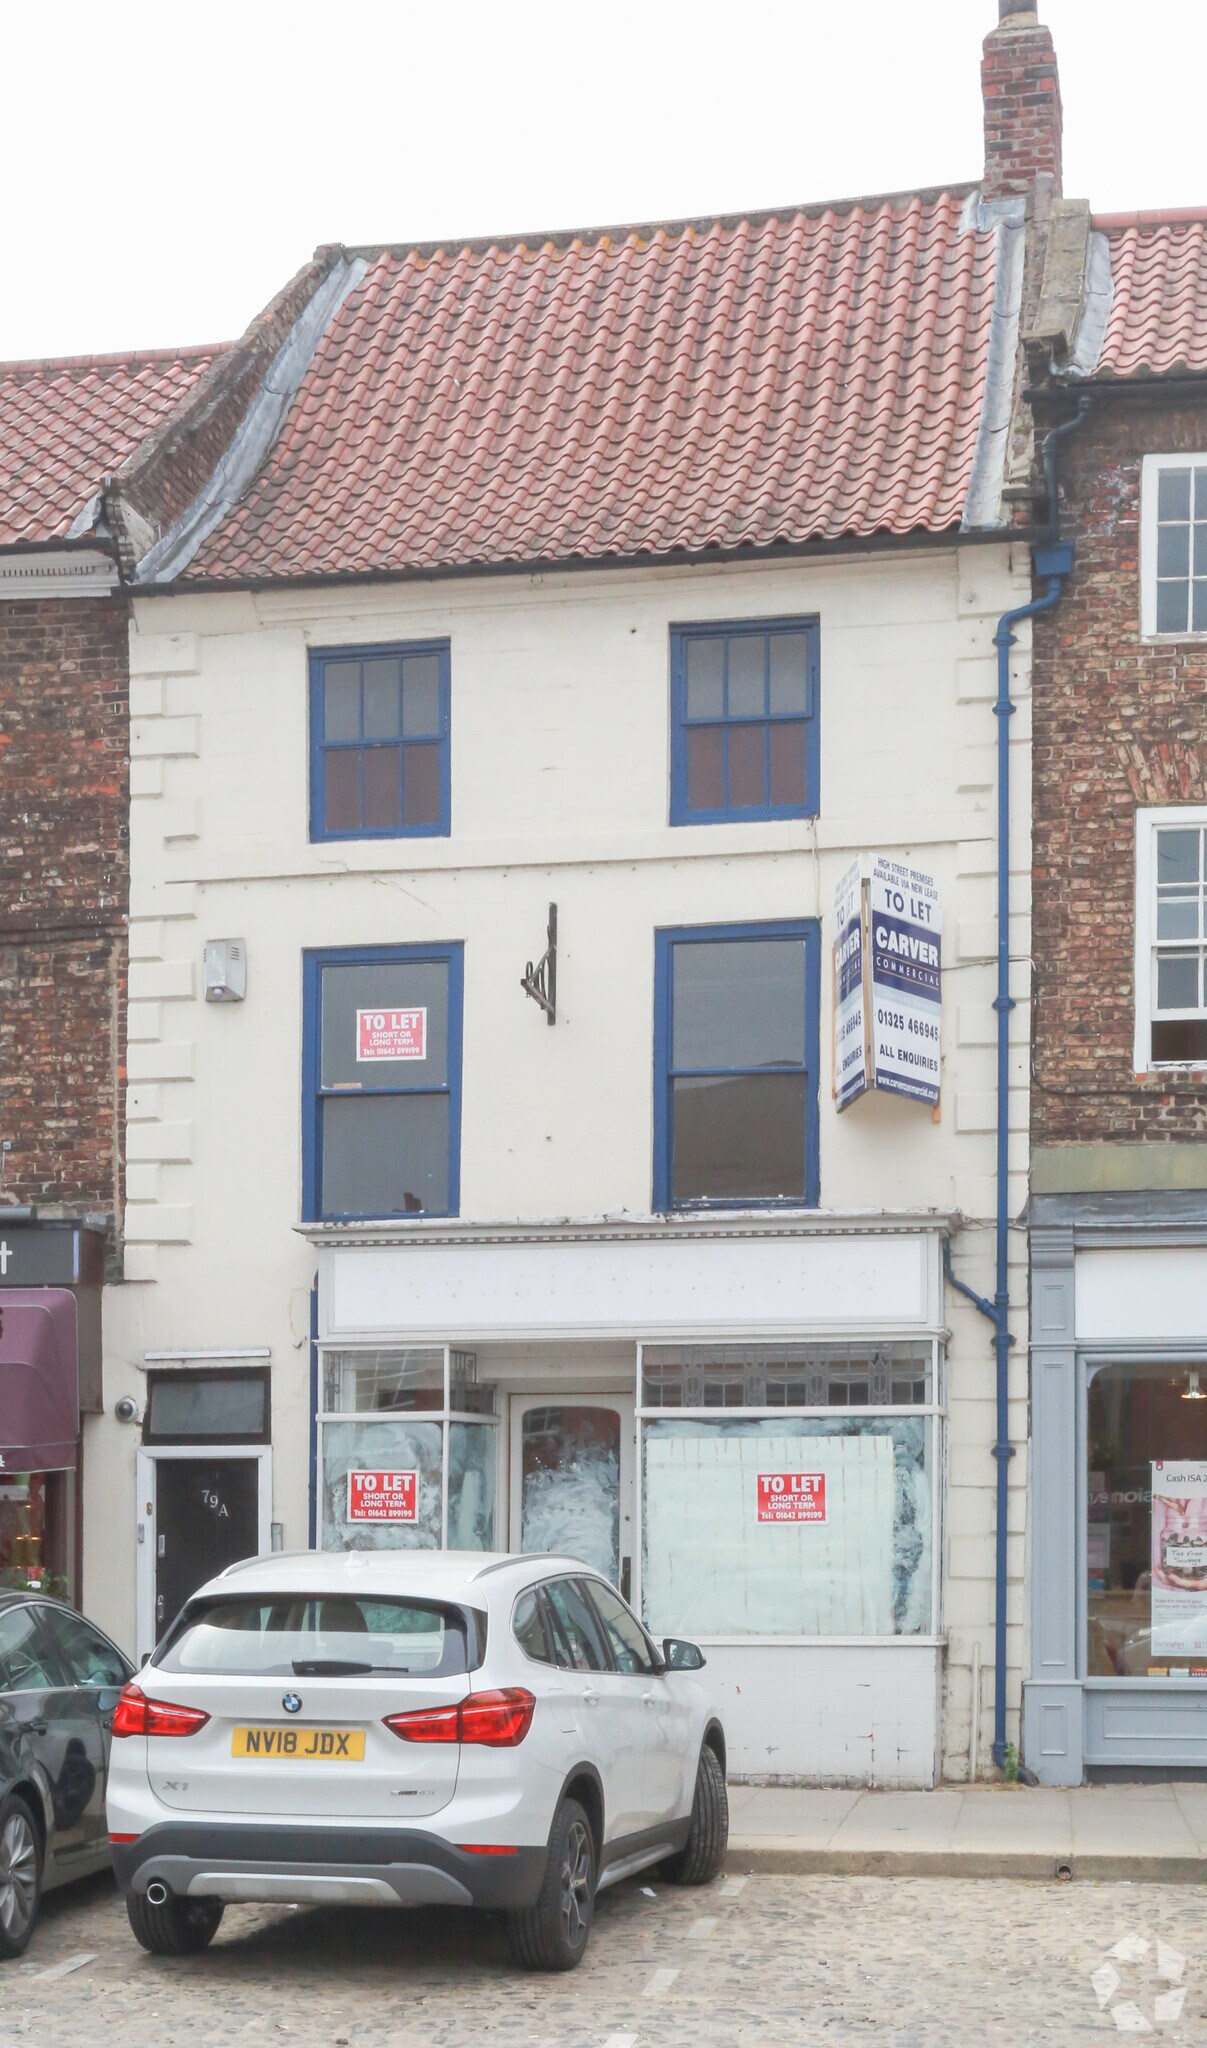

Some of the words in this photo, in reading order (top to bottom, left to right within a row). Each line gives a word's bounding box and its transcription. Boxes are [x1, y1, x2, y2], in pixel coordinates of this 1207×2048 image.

[878, 857, 890, 870] HIGH
[891, 862, 908, 877] STREET
[910, 870, 934, 887] PREMISES
[873, 868, 899, 886] AVAILABLE
[901, 878, 910, 890] VIA
[911, 882, 923, 895] NEW
[924, 887, 938, 901] LEASE
[885, 888, 904, 913] TO
[910, 898, 931, 923] LET
[876, 926, 939, 968] CARVER
[876, 956, 939, 986] COMMERCIAL
[363, 1014, 385, 1031] TO
[391, 1013, 420, 1030] LET
[877, 1008, 904, 1031] 01325
[908, 1018, 939, 1041] 466945
[372, 1031, 398, 1039] SHORT
[400, 1030, 411, 1038] OR
[362, 1048, 375, 1056] Tel:
[880, 1044, 895, 1058] ALL
[898, 1049, 938, 1072] ENQUIRIES
[354, 1475, 377, 1491] TO
[383, 1475, 412, 1491] LET
[761, 1476, 785, 1493] TO
[791, 1476, 822, 1492] LET
[1166, 1474, 1186, 1483] Cash
[1187, 1474, 1202, 1483] ISA
[363, 1492, 390, 1500] SHORT
[770, 1494, 799, 1502] SHORT
[367, 1509, 387, 1517] 01642
[388, 1509, 412, 1517] 899199
[767, 1502, 791, 1510] LONG
[793, 1501, 816, 1509] TERM
[775, 1511, 796, 1519] 01642
[246, 1731, 298, 1753] NV18
[304, 1732, 350, 1755] JDX
[162, 1781, 189, 1791] X1
